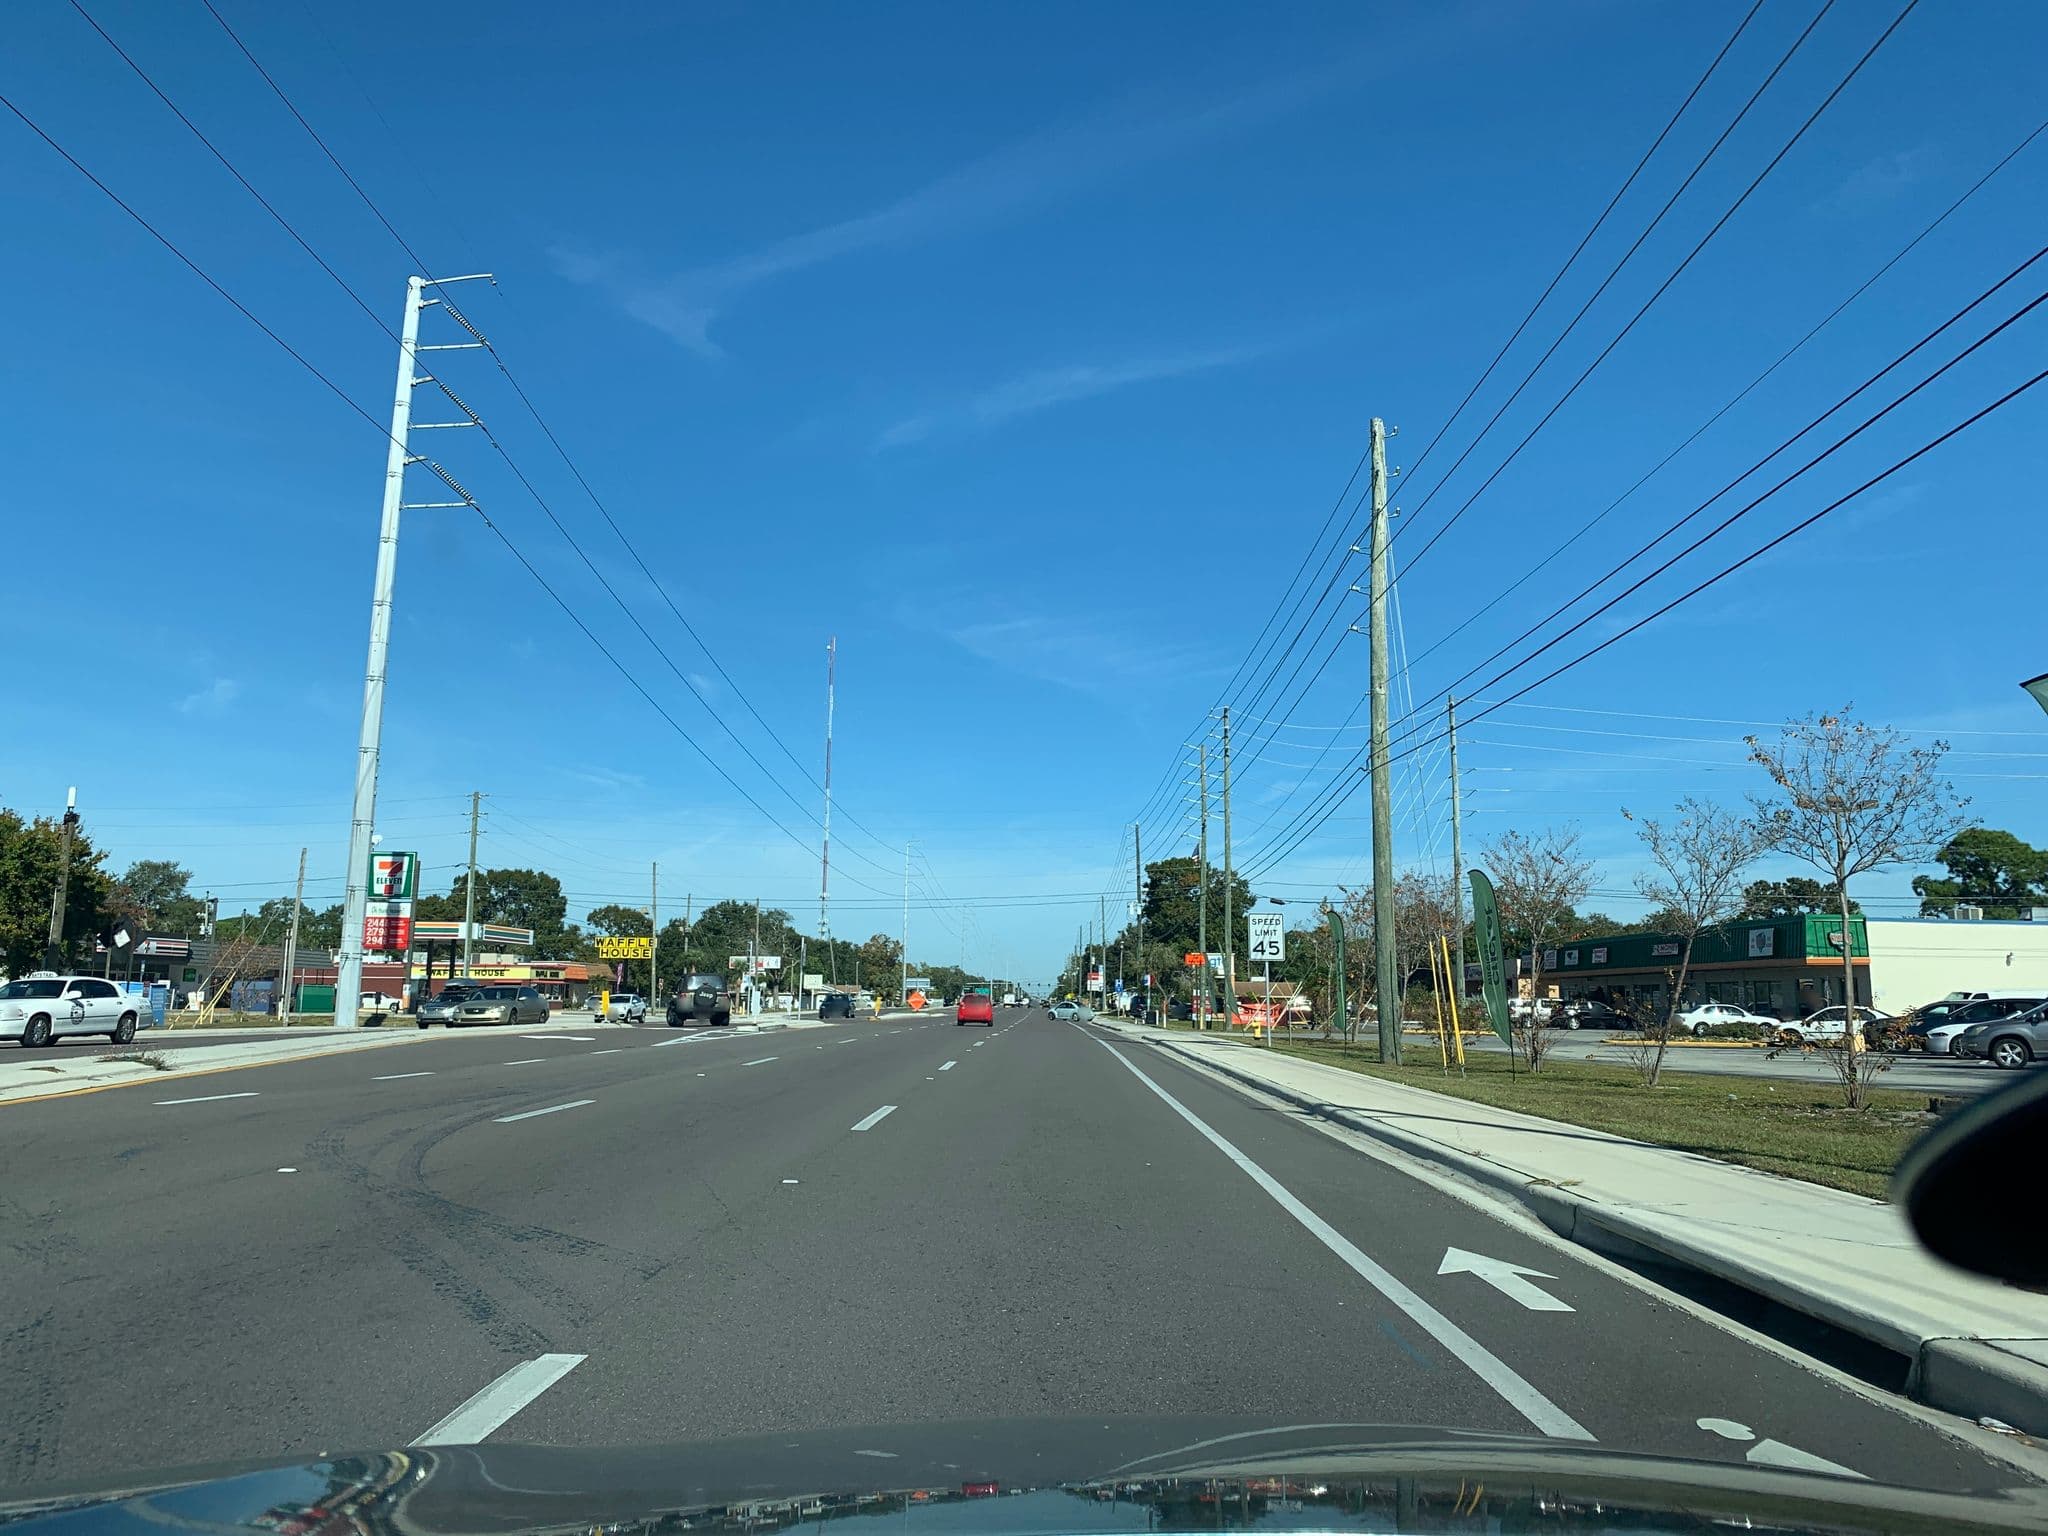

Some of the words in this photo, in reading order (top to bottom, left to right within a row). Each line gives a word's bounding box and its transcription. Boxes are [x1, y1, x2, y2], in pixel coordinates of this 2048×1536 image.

[1251, 918, 1281, 926] SPEED
[596, 938, 654, 947] WAFFLE
[1252, 940, 1280, 956] 45
[600, 949, 650, 957] HOUSE
[474, 969, 505, 977] HOUSE
